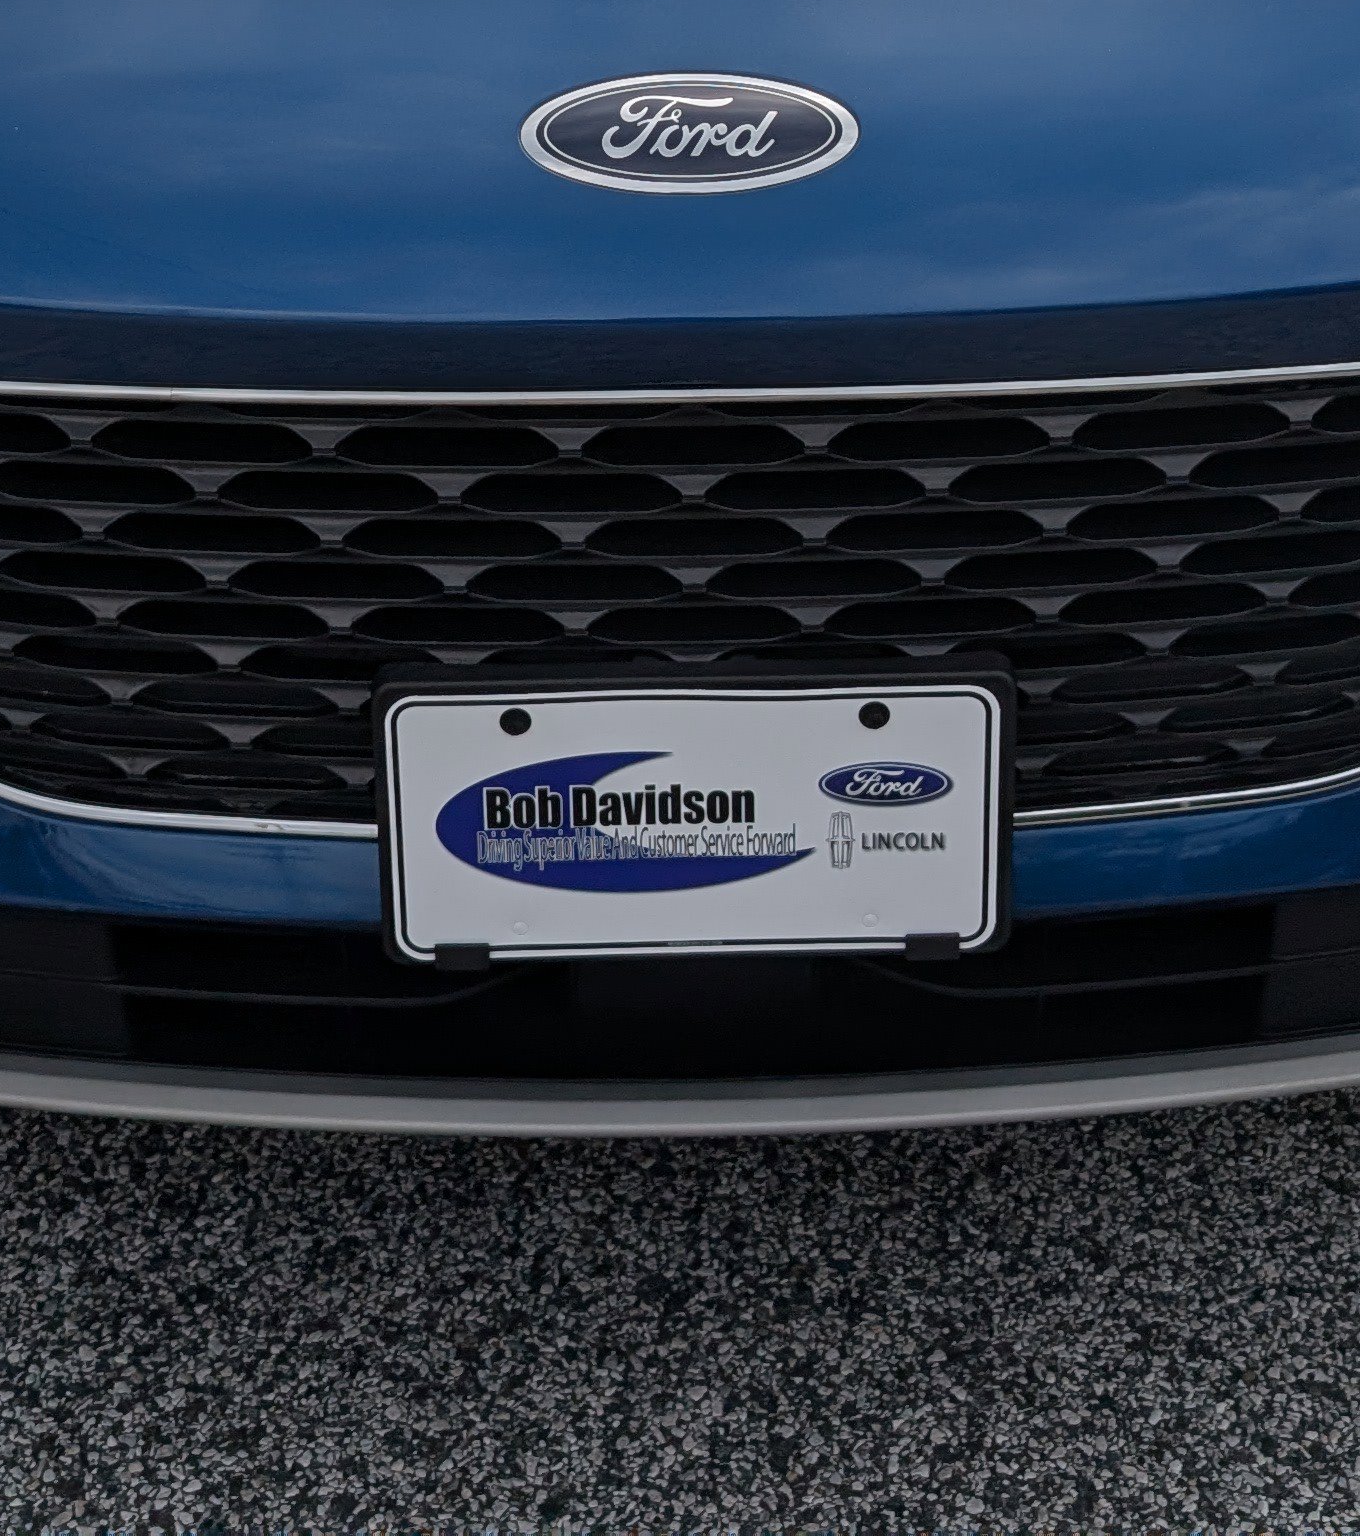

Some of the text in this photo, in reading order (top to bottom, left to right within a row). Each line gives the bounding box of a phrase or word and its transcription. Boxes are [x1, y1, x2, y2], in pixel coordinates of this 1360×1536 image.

[601, 95, 779, 159] Ford
[845, 768, 925, 796] Ford
[484, 783, 755, 829] Bob Davidson
[476, 822, 797, 871] Driving Superior Value And Customer Service Forward
[860, 831, 947, 852] LINCOLN
